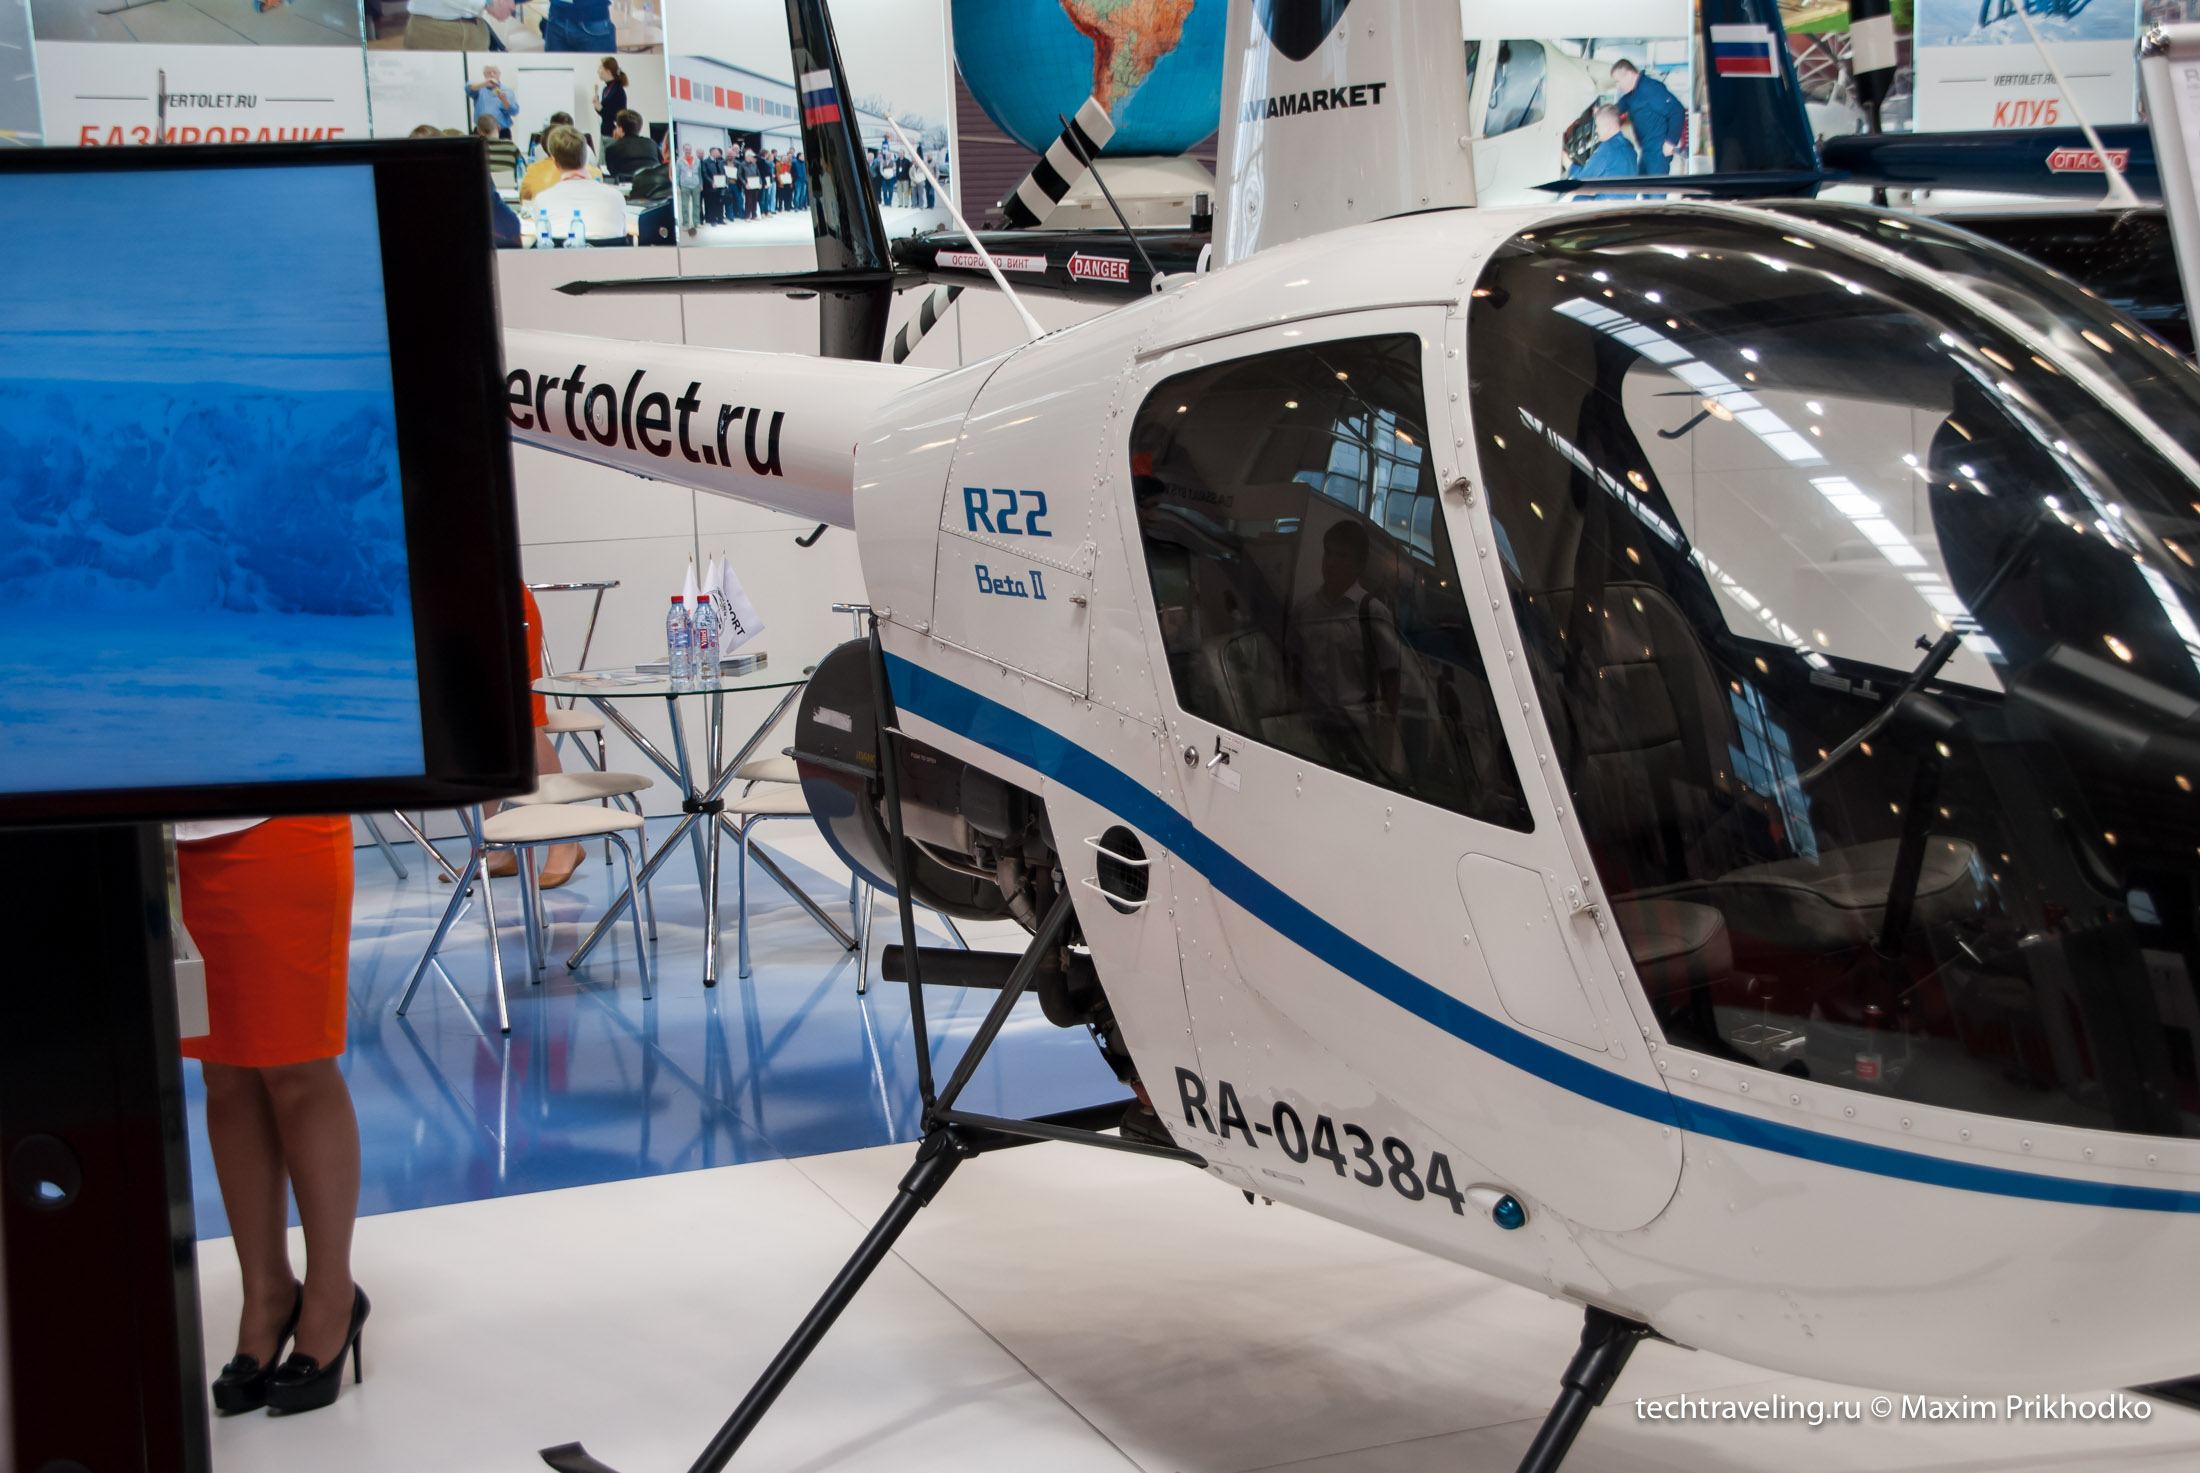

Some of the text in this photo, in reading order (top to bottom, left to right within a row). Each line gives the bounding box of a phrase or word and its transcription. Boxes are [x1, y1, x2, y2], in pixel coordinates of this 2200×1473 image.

[163, 94, 257, 109] ERTOLET.RU
[1992, 99, 2059, 128] КЛУБ
[951, 255, 1029, 269] ОСТОРОНО ВИНТ
[1074, 260, 1128, 279] DANGER
[506, 364, 785, 477] ertolet.ru
[963, 487, 1052, 537] R22
[974, 564, 1029, 598] Beta
[1174, 1066, 1466, 1216] RA-04384
